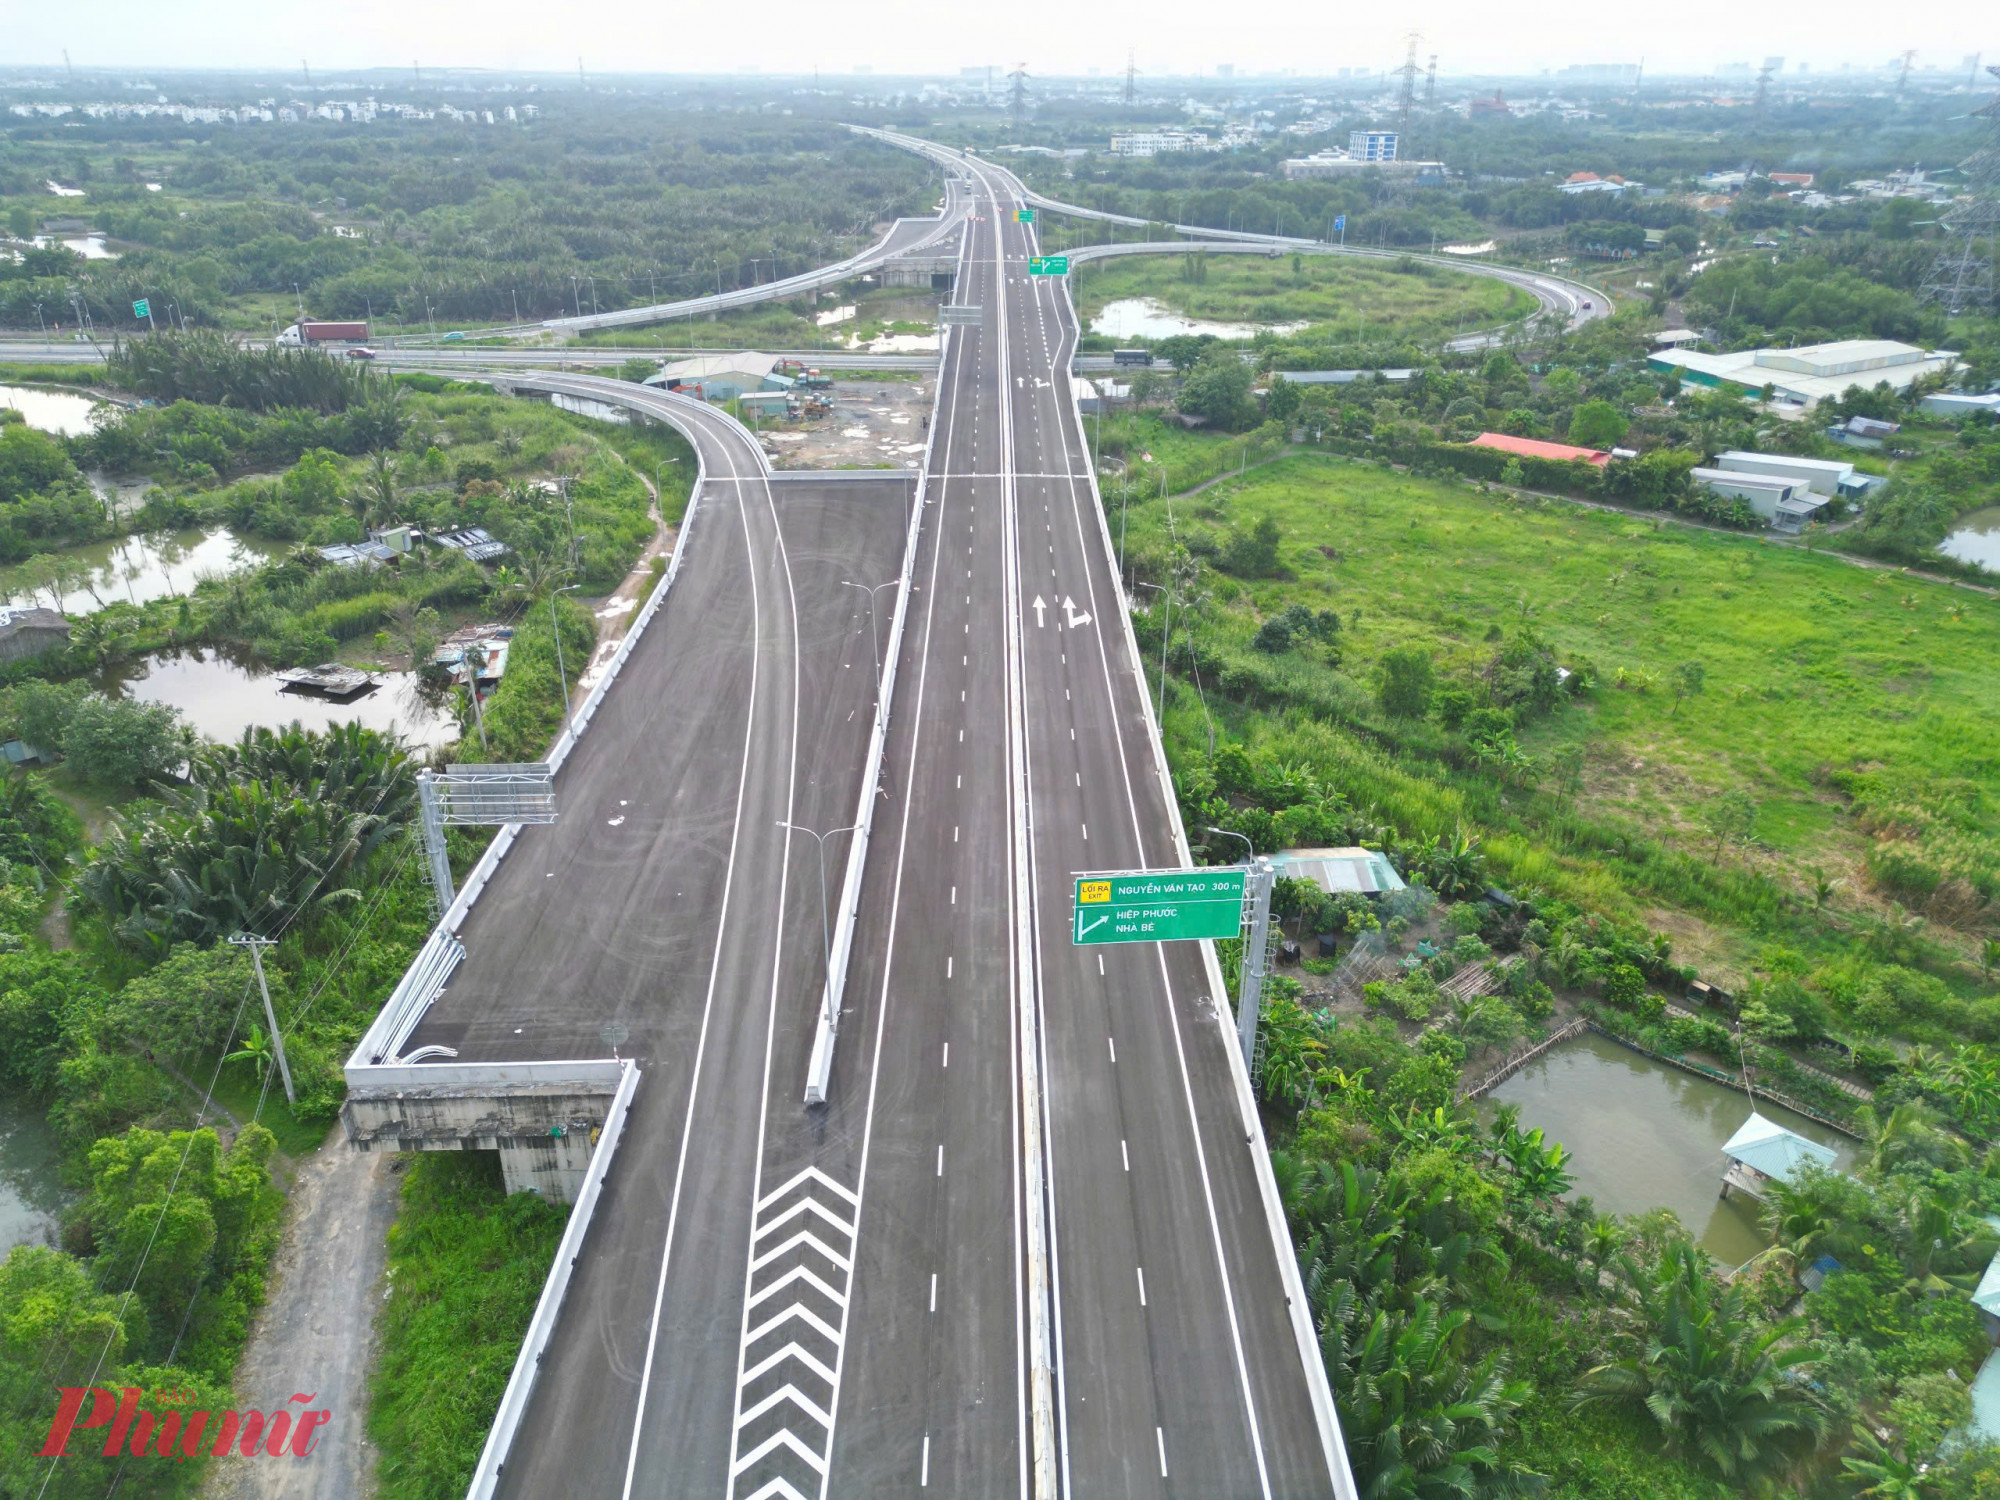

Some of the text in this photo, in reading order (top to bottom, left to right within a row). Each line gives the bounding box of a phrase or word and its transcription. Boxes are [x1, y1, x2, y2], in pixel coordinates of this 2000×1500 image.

[1118, 883, 1160, 894] NGUYỄN
[1212, 882, 1229, 890] 300
[1116, 922, 1138, 932] NHÀ
